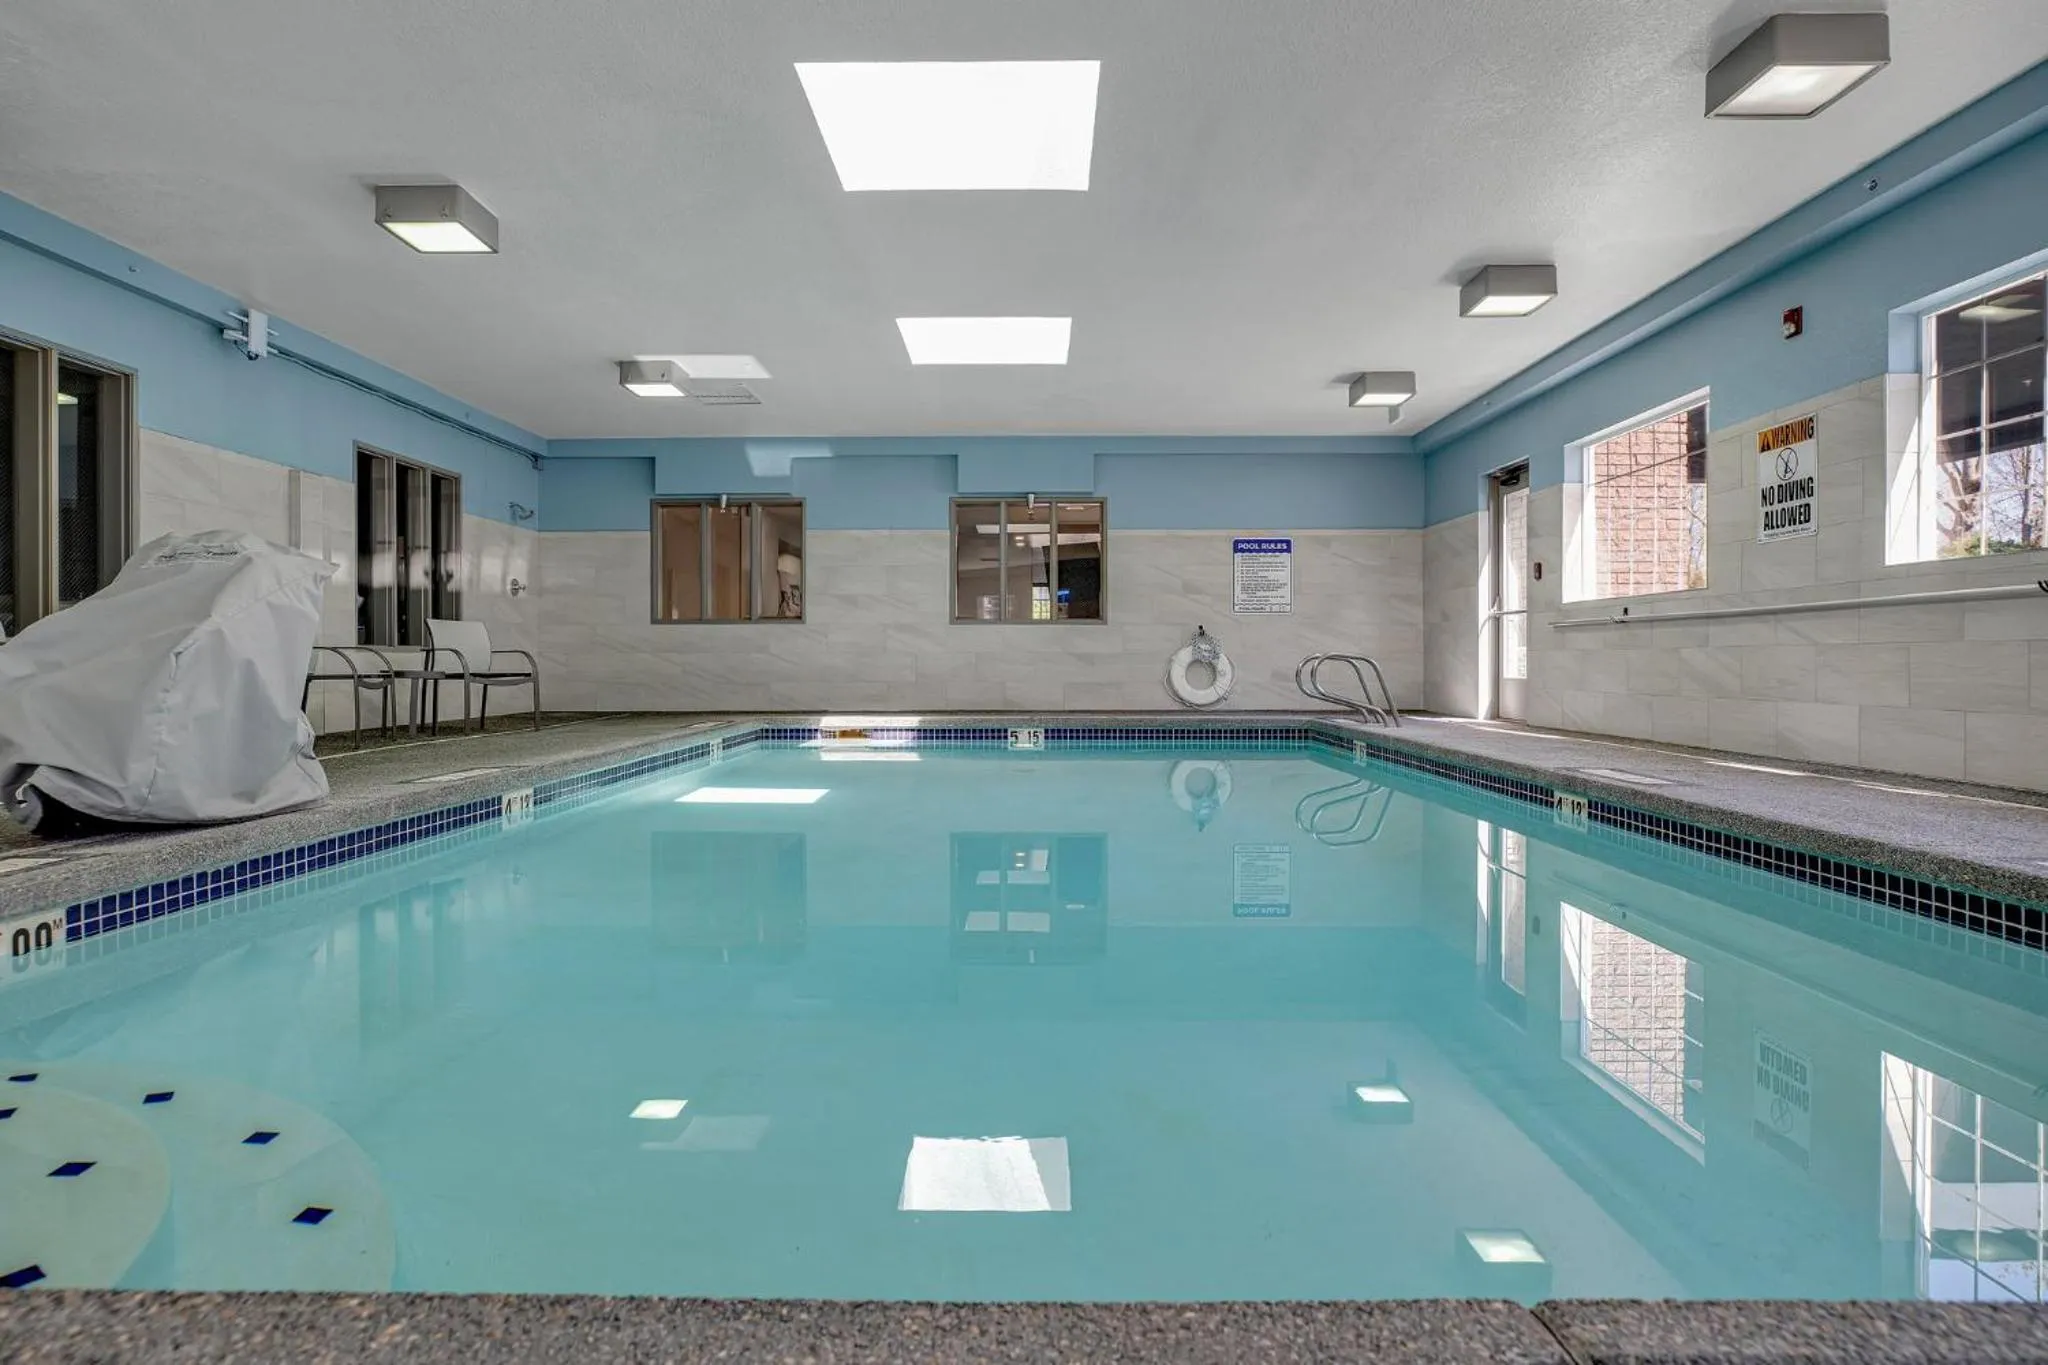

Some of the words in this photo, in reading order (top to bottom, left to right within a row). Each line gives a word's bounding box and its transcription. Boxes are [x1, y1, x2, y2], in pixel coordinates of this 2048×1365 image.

[1771, 417, 1814, 450] WARNING
[1761, 485, 1774, 508] NO
[1777, 476, 1814, 504] DIVING
[1763, 503, 1811, 531] ALLOWED
